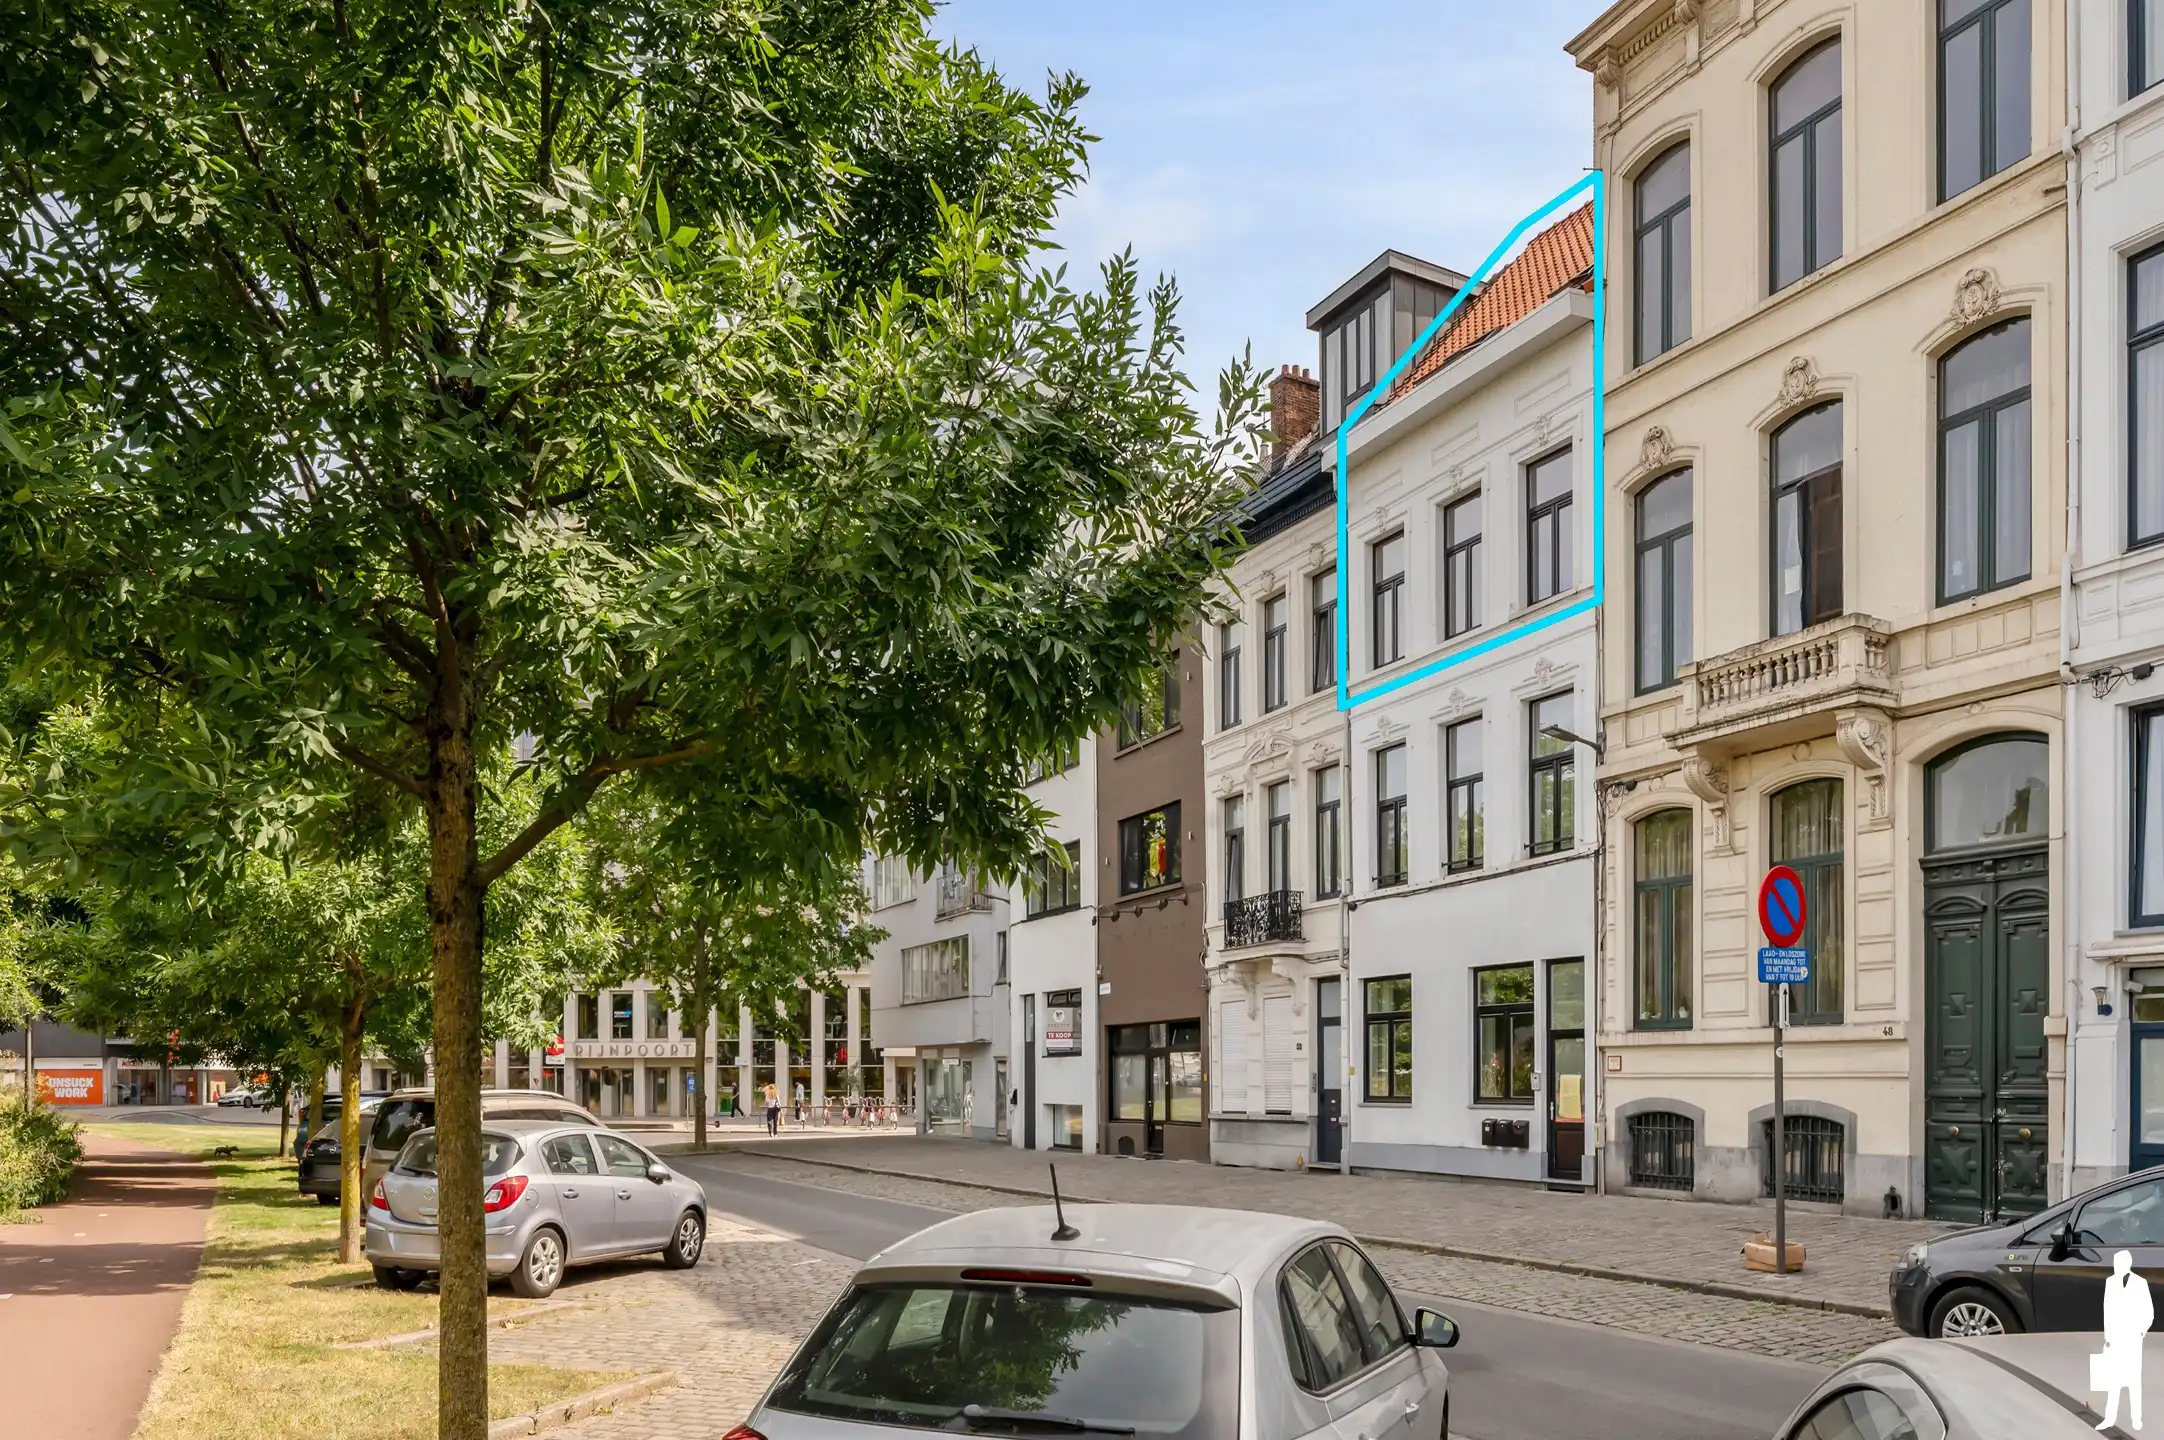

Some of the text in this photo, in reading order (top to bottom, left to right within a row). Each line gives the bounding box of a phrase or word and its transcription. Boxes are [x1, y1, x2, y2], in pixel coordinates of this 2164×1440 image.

[1882, 1026, 1894, 1037] 48
[575, 1044, 692, 1057] RIJNPOORT
[48, 1077, 94, 1088] UNSUCK
[54, 1087, 88, 1098] WORK
